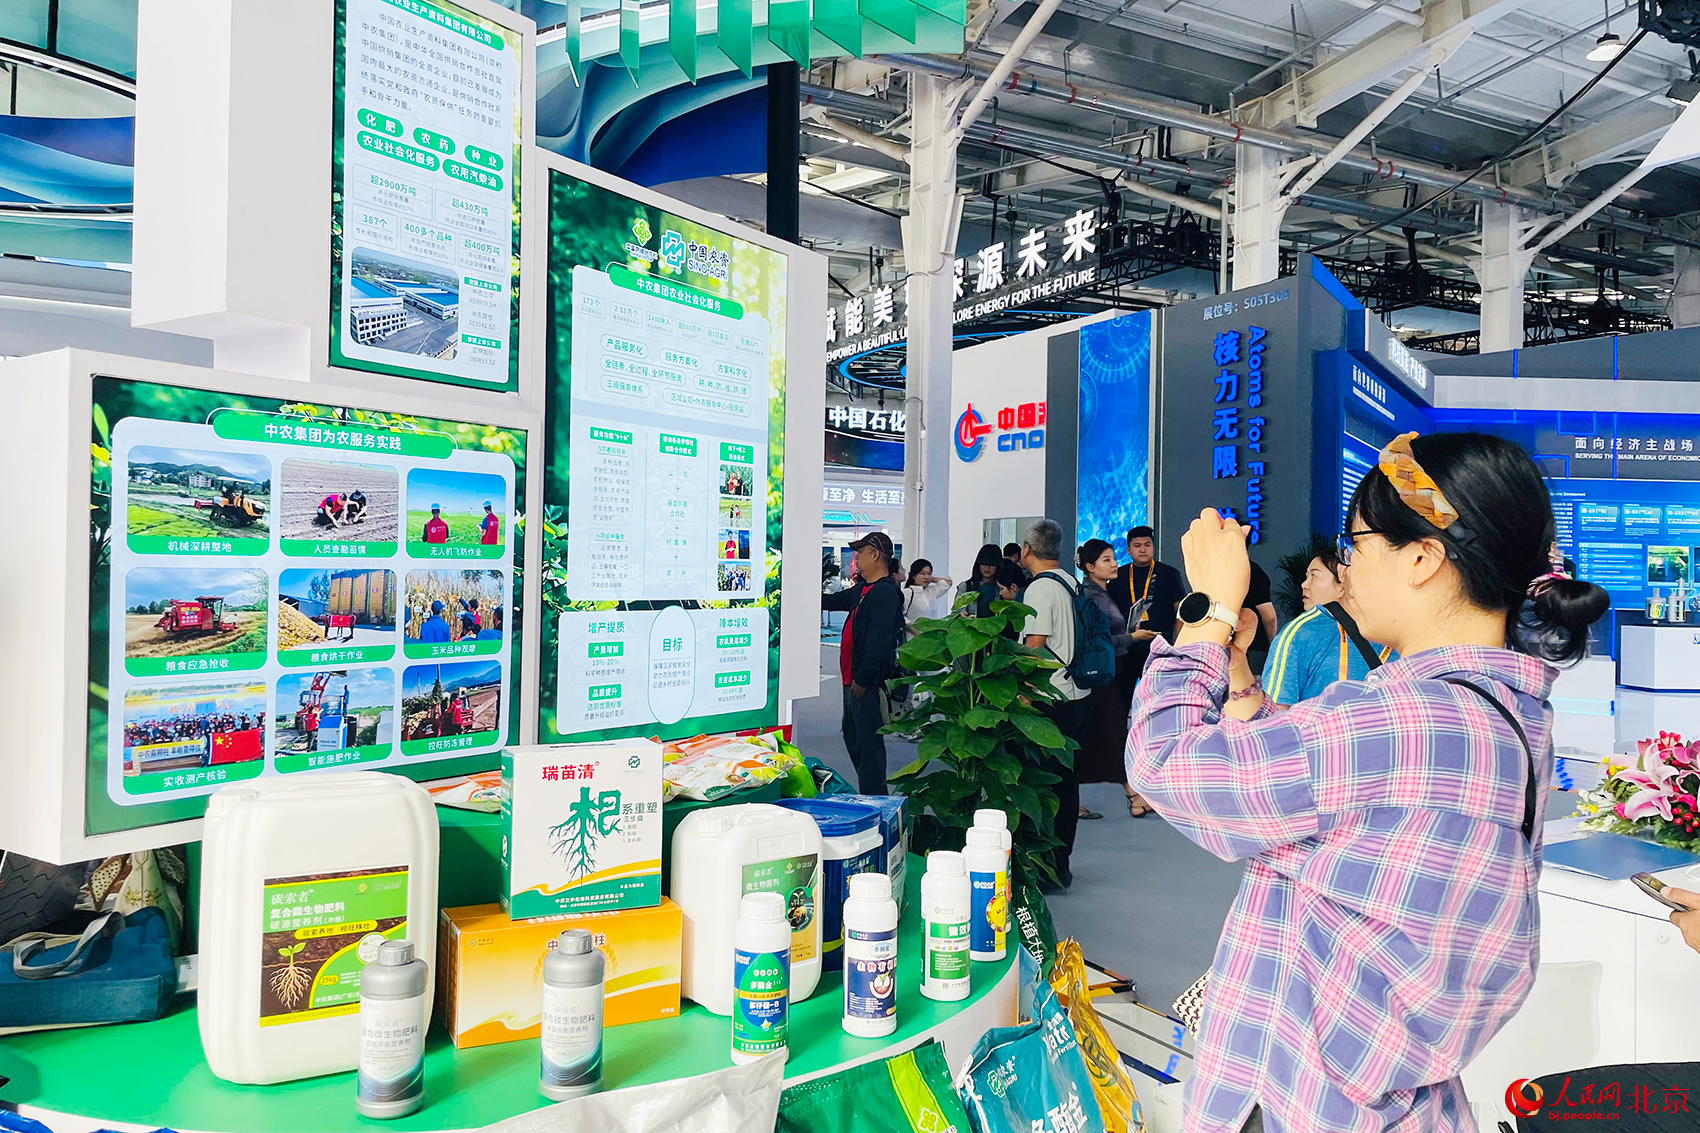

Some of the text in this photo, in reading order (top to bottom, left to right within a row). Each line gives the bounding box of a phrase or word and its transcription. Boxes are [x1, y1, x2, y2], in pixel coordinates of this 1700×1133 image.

[362, 134, 436, 168] 农业社会化服务
[450, 164, 497, 189] 农用汽柴油
[636, 277, 721, 312] 中农集团农业社会化服务
[863, 330, 899, 351] BEAUTIFUL
[974, 295, 1011, 317] ENERGY
[1011, 288, 1031, 305] FOR
[1032, 281, 1052, 299] THE
[1053, 267, 1095, 293] FUTURE
[606, 338, 643, 356] 产品服务化
[1213, 330, 1241, 478] 核力无限
[264, 423, 402, 451] 中农集团为农服务实践
[1246, 325, 1267, 545] Atoms for Future
[168, 541, 232, 552] 机械深耕整地
[313, 544, 366, 554] 人员查勘苗情
[430, 546, 482, 557] 无人机飞防作业
[587, 621, 625, 634] 增产提质
[719, 617, 748, 628] 降本增效
[431, 644, 476, 655] 玉米品种观摩
[662, 637, 683, 652] 目标
[166, 658, 229, 671] 粮食应急抢收
[311, 651, 364, 662] 粮食烘干作业
[428, 737, 473, 750] 控旺防冻管理
[308, 751, 361, 767] 智能施肥作业
[163, 769, 227, 788] 实收测产核验
[542, 764, 595, 781] 瑞苗清
[622, 802, 658, 815] 系重塑
[270, 901, 346, 919] 复合微生物肥料
